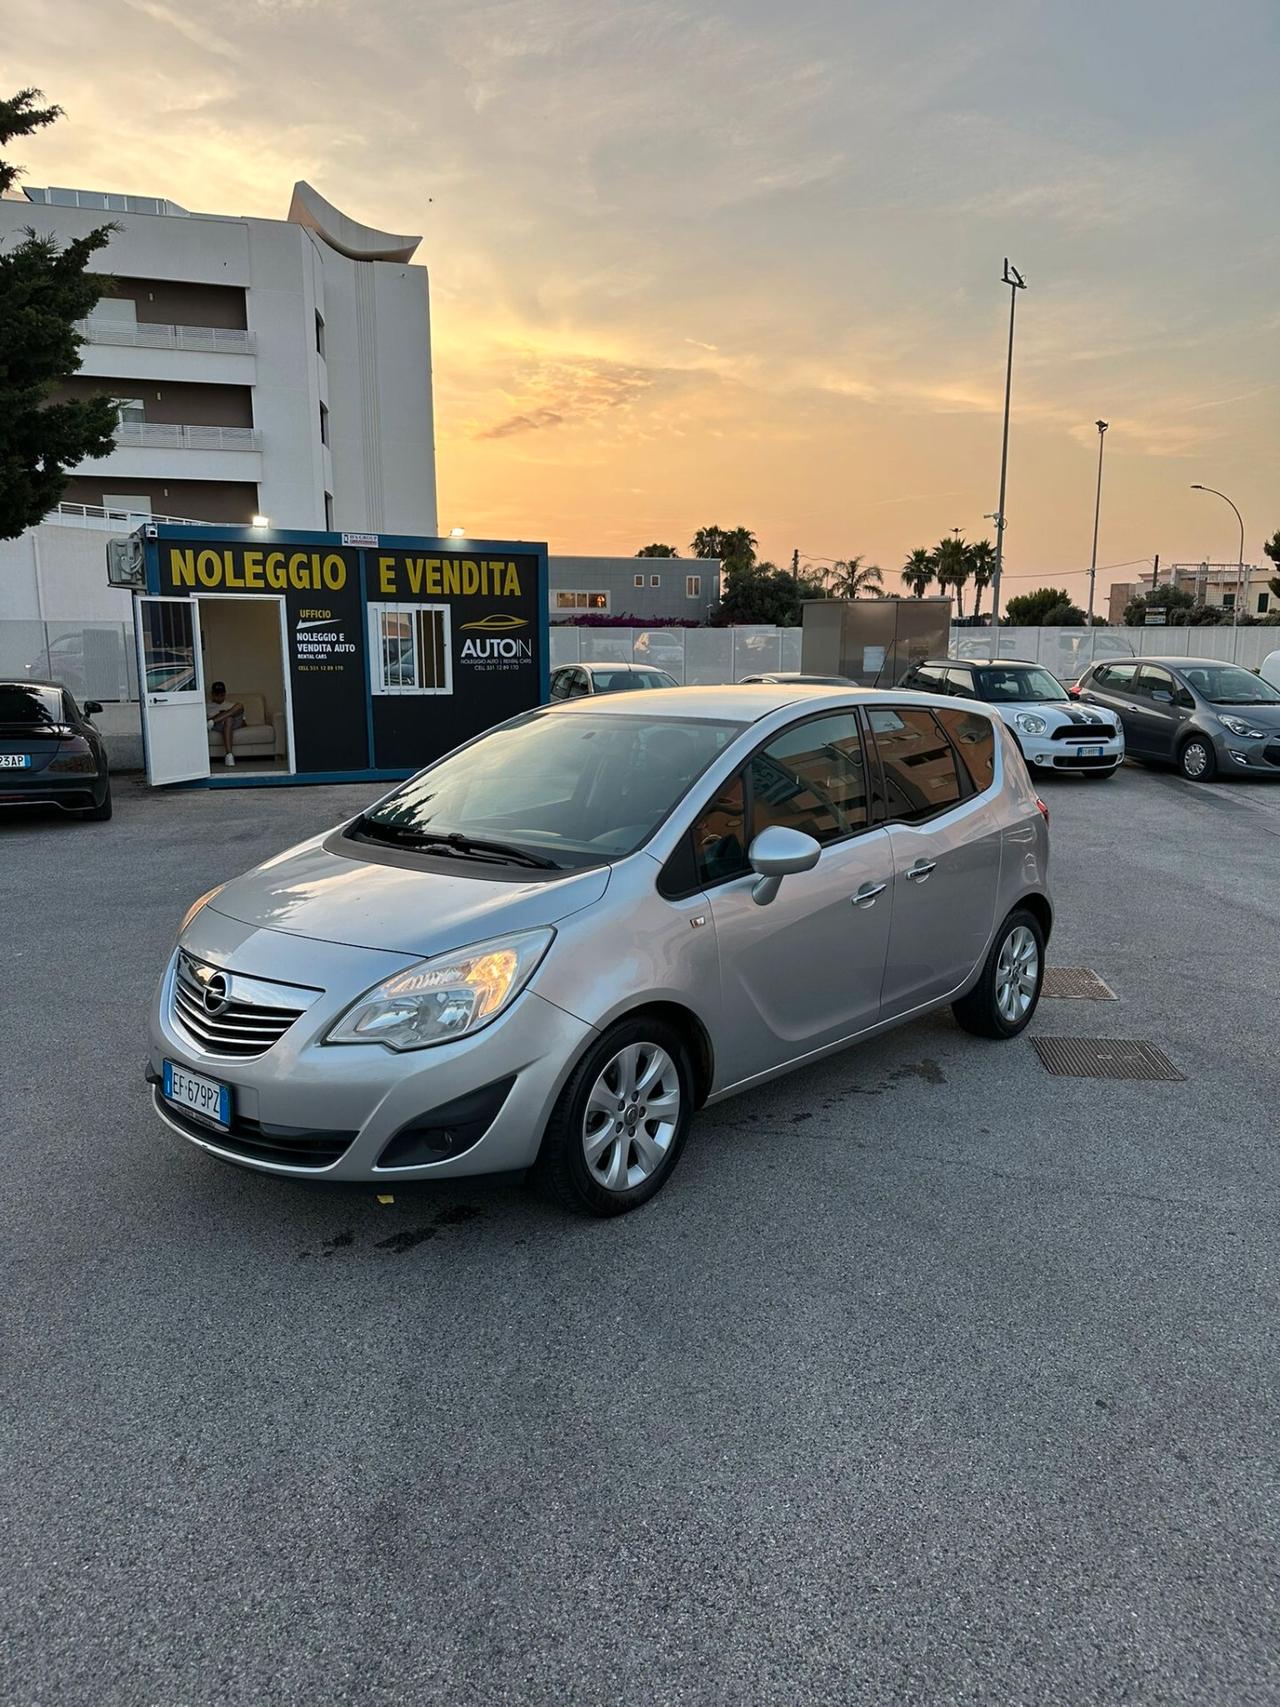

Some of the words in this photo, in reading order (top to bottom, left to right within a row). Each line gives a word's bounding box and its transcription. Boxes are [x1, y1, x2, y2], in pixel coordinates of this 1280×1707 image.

[170, 549, 347, 591] NOLEGGIO
[379, 557, 397, 593] E
[405, 558, 522, 596] VENDITA
[300, 609, 331, 618] UFFICIO
[297, 632, 337, 641] NOLEGGIO
[339, 633, 345, 641] E
[297, 643, 332, 652] VENDITA
[334, 644, 356, 652] AUTO
